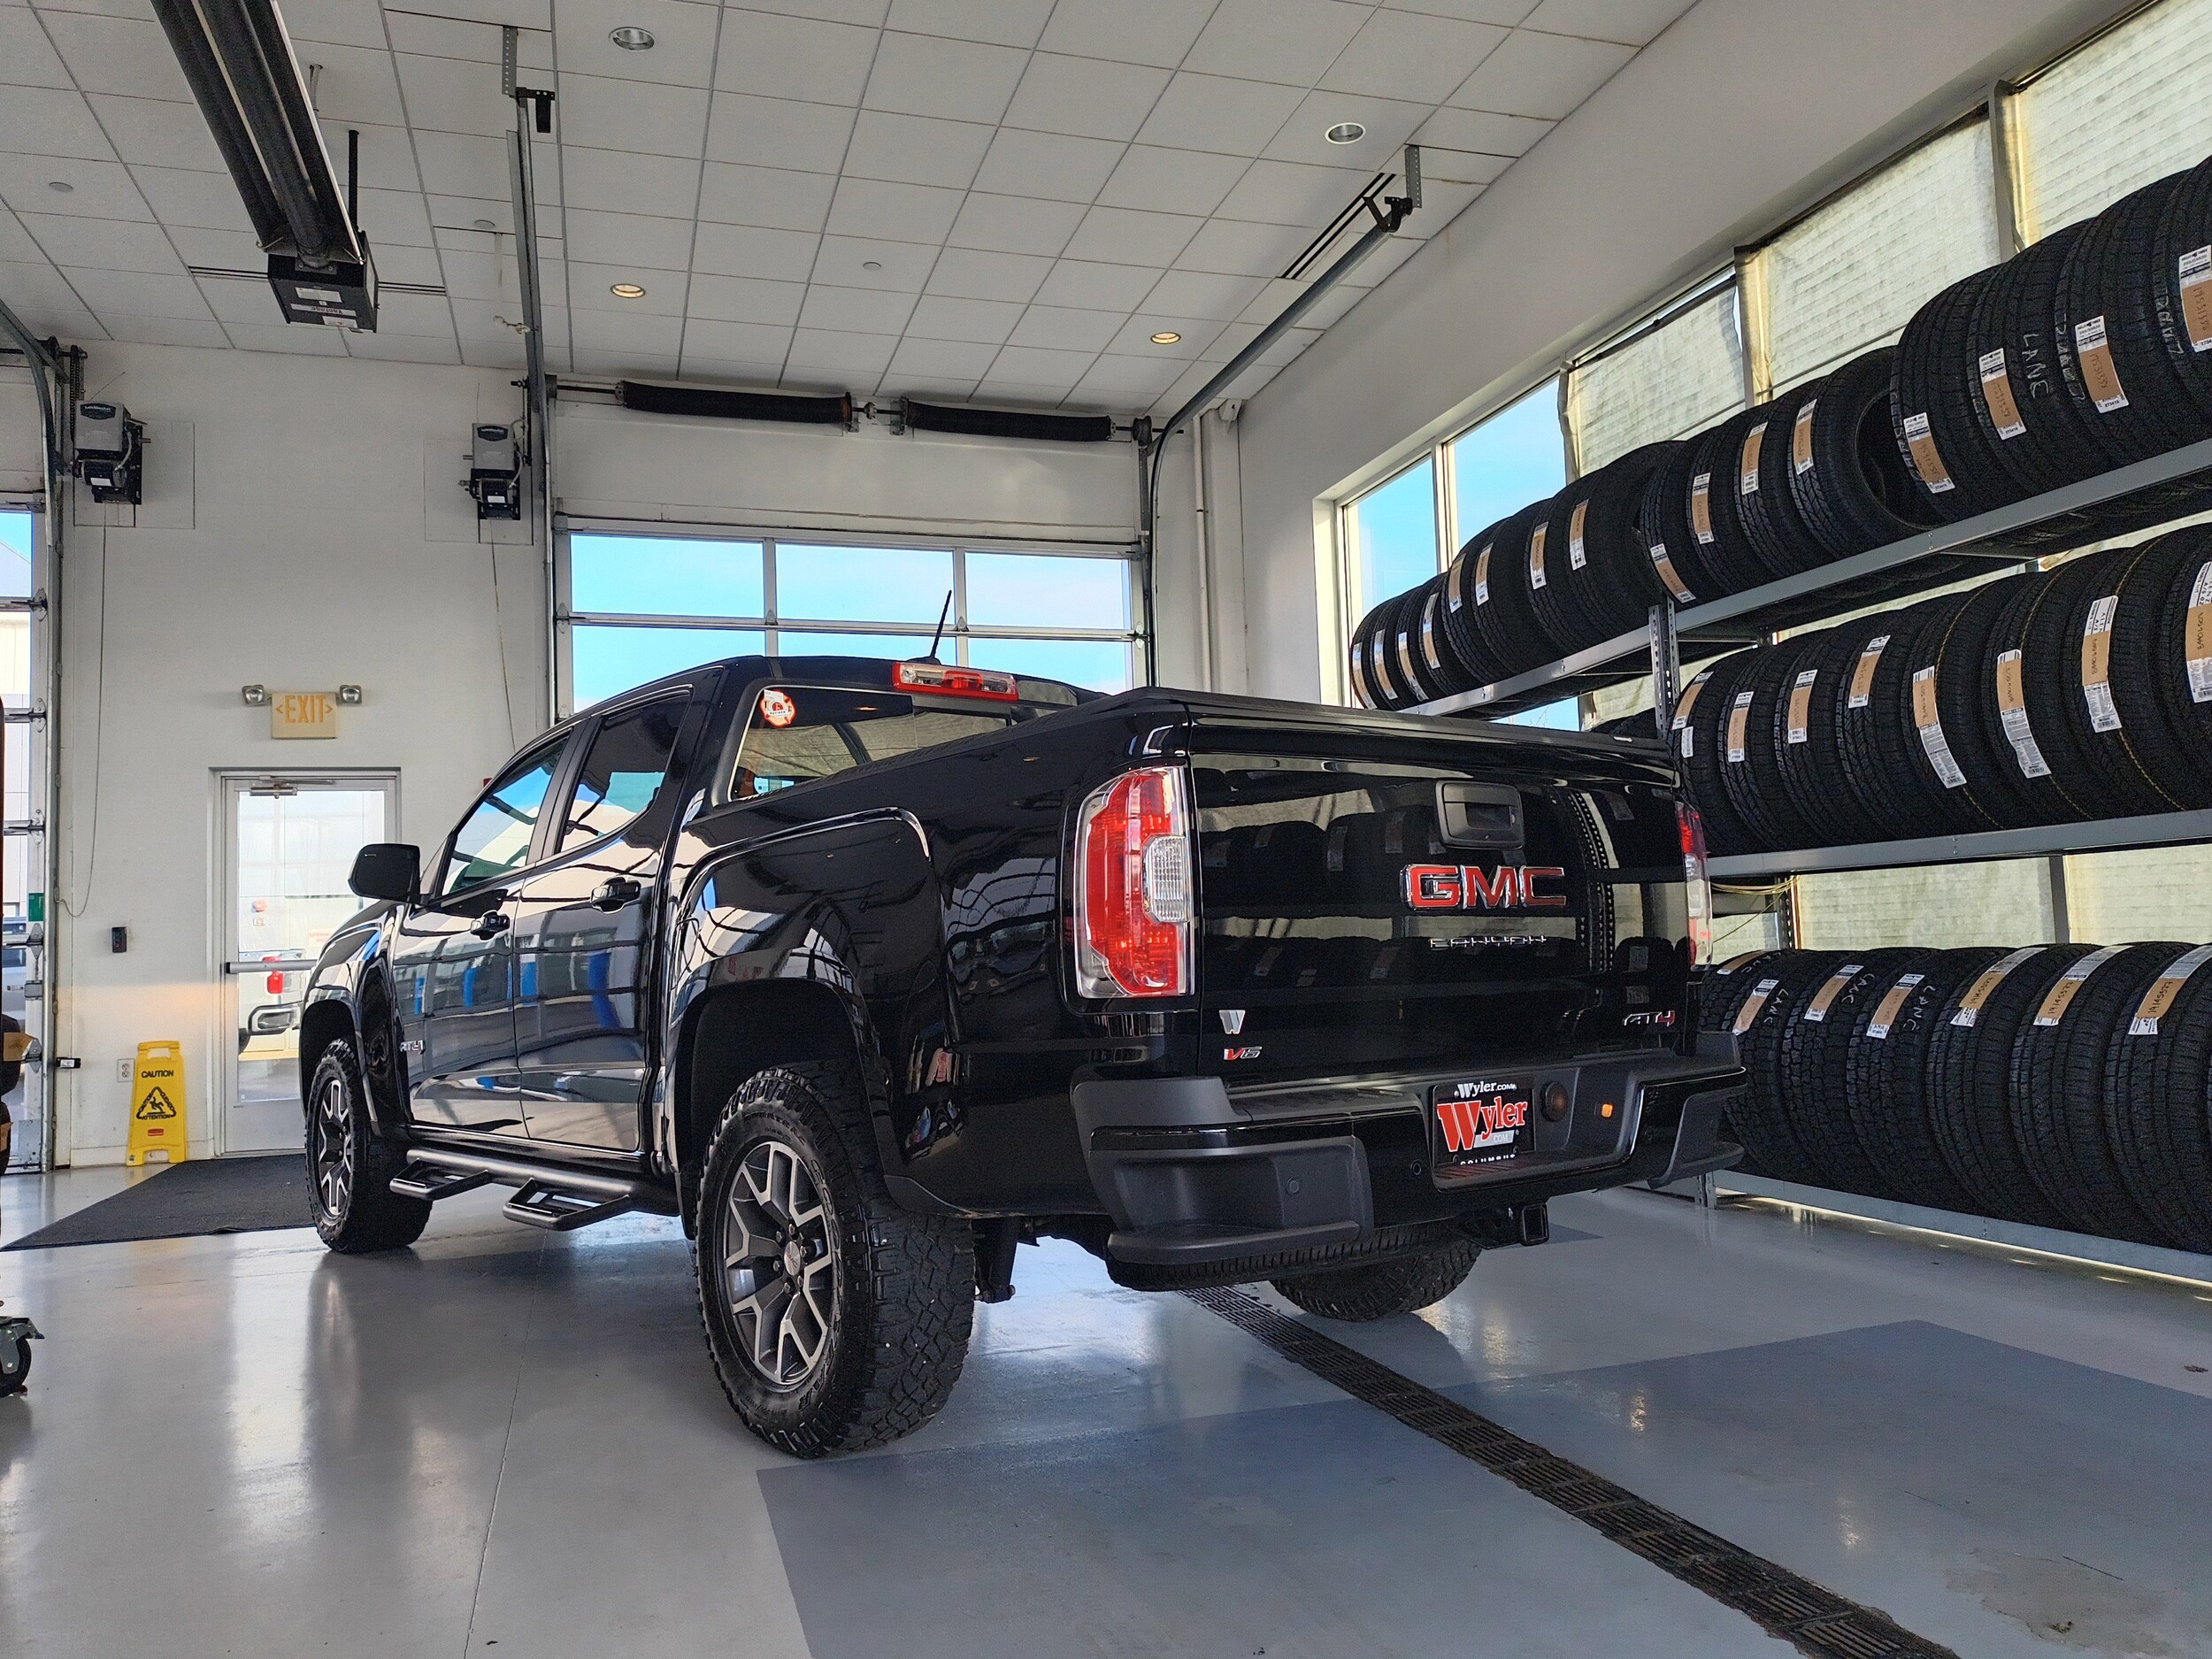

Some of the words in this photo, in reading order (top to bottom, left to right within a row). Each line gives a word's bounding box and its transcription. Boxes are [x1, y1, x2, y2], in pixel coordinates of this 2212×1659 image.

[285, 695, 326, 723] EXIT
[1401, 864, 1567, 911] GMC
[1623, 1010, 1676, 1027] AT4
[1224, 1046, 1263, 1060] V6
[141, 1070, 174, 1079] CAUTION
[1437, 1096, 1528, 1152] Wyler
